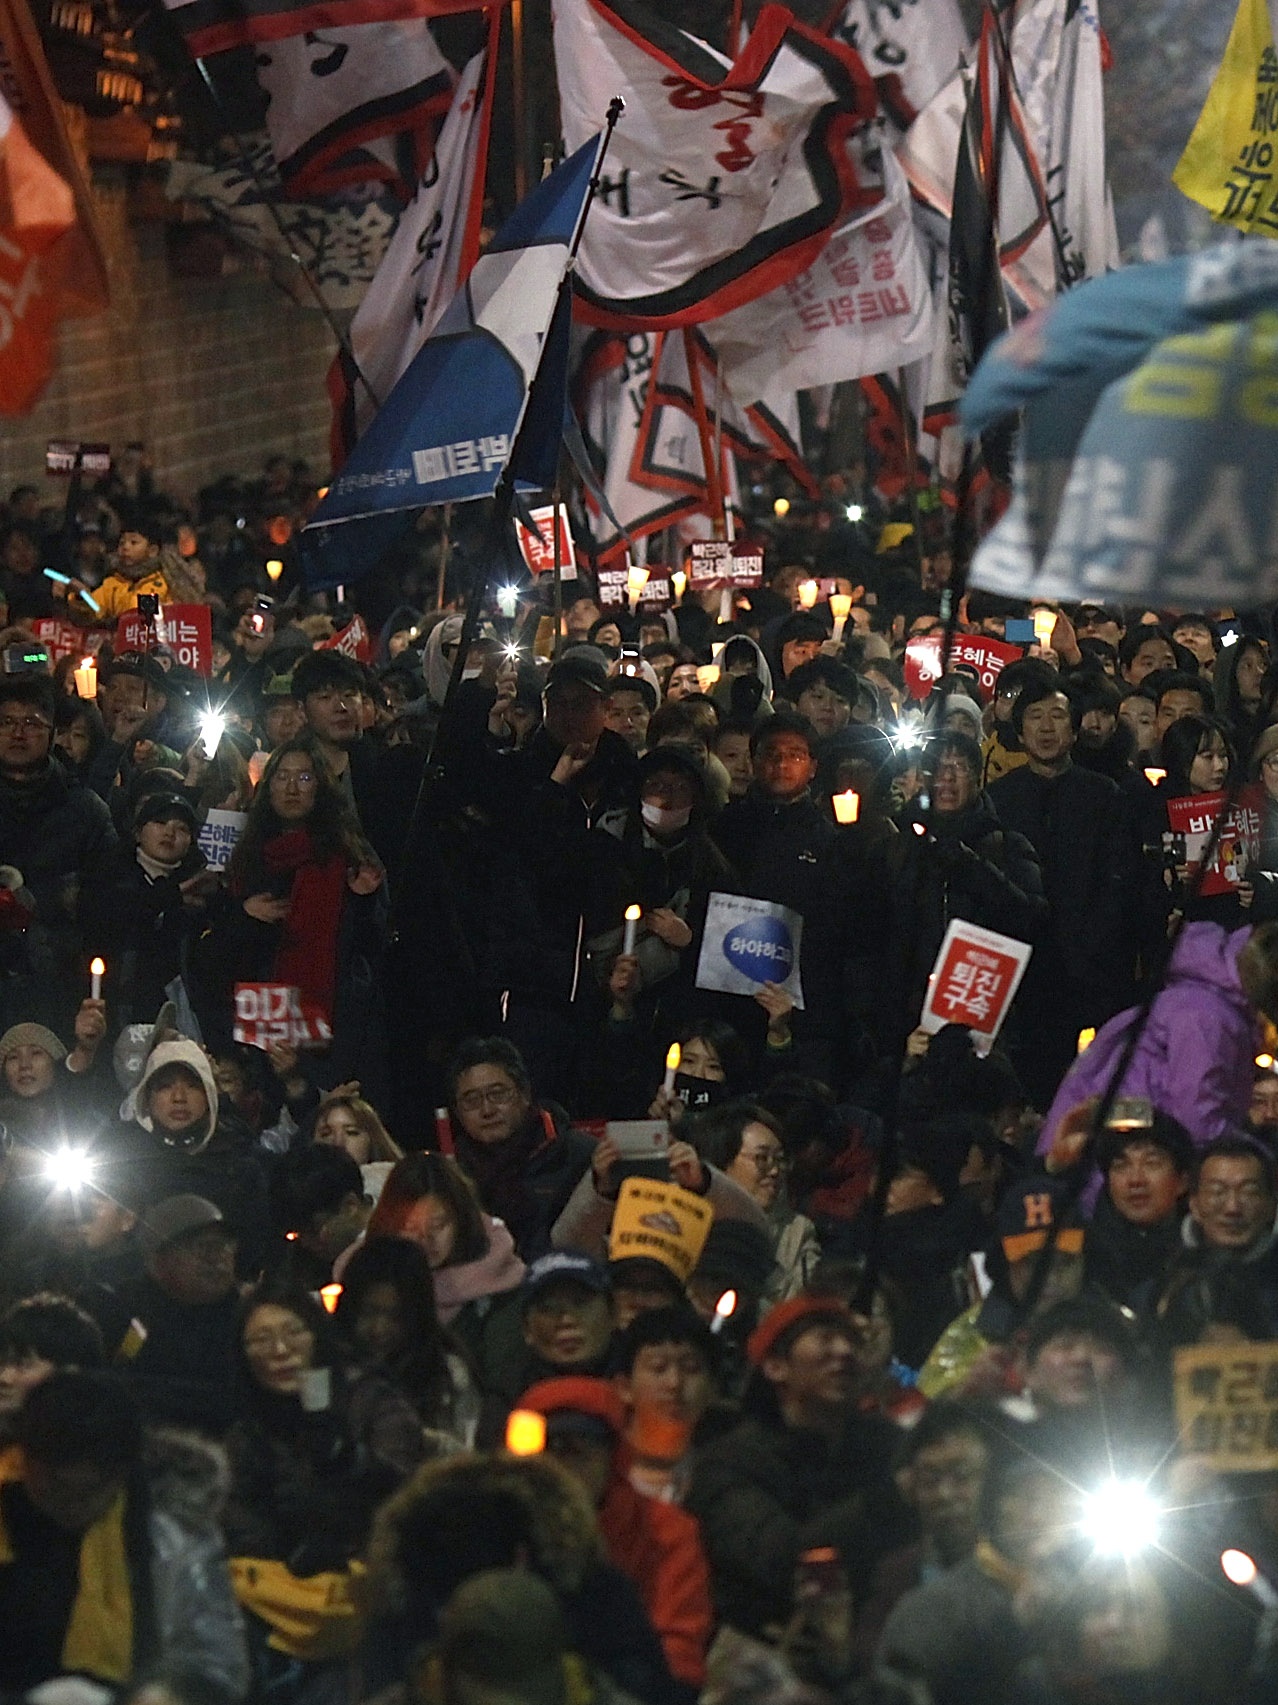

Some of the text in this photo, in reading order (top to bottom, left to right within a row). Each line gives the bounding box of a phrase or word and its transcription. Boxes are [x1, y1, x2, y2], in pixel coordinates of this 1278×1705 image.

[948, 961, 1003, 999] 퇴진
[943, 984, 992, 1021] 구속
[1023, 1193, 1053, 1225] H
